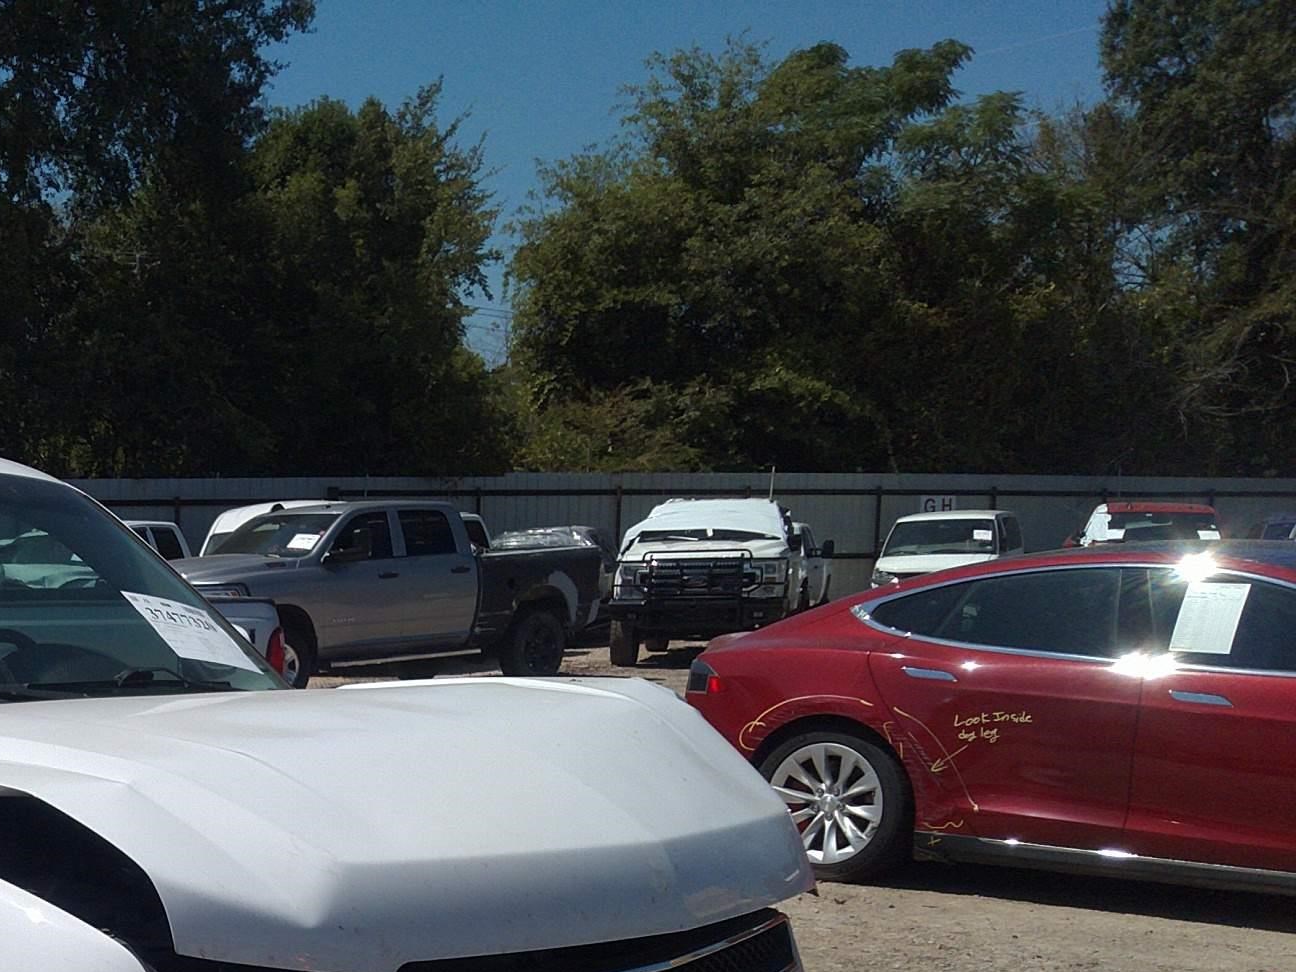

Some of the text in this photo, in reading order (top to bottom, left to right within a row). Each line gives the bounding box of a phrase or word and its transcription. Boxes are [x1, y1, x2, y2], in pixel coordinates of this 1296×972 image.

[954, 711, 1033, 727] Look Inside
[980, 727, 1000, 743] leg
